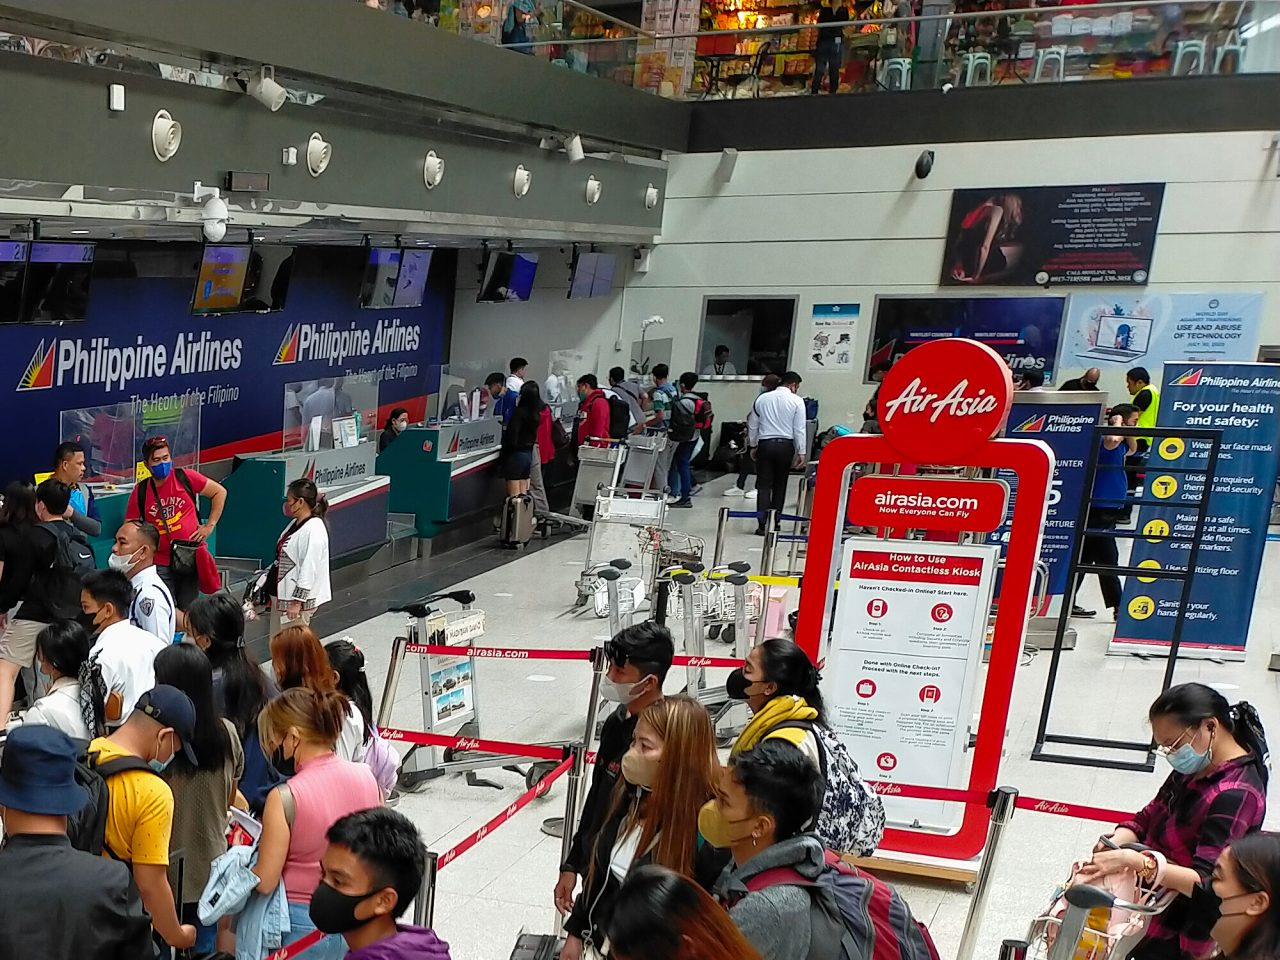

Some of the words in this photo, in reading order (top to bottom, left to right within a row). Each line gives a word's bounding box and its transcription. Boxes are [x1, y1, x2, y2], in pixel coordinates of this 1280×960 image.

[13, 241, 27, 260] 21
[82, 246, 93, 262] 22
[298, 322, 370, 367] Philippine
[371, 318, 420, 354] Airlines
[56, 336, 167, 392] Philippine
[170, 331, 243, 376] Airlines
[377, 366, 385, 379] of
[385, 364, 395, 380] the
[396, 362, 418, 382] Filipino
[1199, 376, 1249, 388] Philippine
[130, 394, 148, 415] The
[150, 392, 178, 412] Heart
[180, 388, 192, 408] of
[191, 387, 205, 405] the
[207, 384, 239, 408] Filipino
[1173, 401, 1196, 411] For
[1199, 403, 1230, 413] your
[1232, 402, 1274, 414] health
[1048, 415, 1095, 424] Philippine
[1186, 416, 1211, 425] and
[1214, 416, 1259, 428] safety:
[1045, 424, 1082, 433] Airlines
[1191, 441, 1213, 449] Wear
[1232, 443, 1250, 451] face
[1251, 443, 1272, 452] mask
[315, 465, 343, 485] Philippine
[344, 462, 366, 480] Airlines
[1220, 476, 1254, 486] required
[1215, 485, 1230, 493] and
[1231, 486, 1263, 495] security
[875, 491, 978, 510] airasia.com
[879, 506, 897, 514] Now
[899, 508, 936, 517] Everyone
[956, 510, 970, 519] Fly
[1218, 516, 1235, 524] safe
[1217, 525, 1227, 533] all
[1228, 526, 1251, 534] times.
[1215, 535, 1235, 543] floor
[1199, 544, 1233, 552] markers.
[889, 553, 911, 562] How
[914, 554, 925, 563] to
[927, 556, 946, 564] Use
[853, 562, 889, 572] AirAsia
[891, 564, 949, 576] Contactless
[952, 567, 981, 578] Kiosk
[1220, 567, 1240, 575] floor
[881, 585, 914, 593] Checked-in
[1184, 611, 1218, 621] egularly.
[467, 646, 529, 659] airasia.com
[923, 670, 941, 678] steps.
